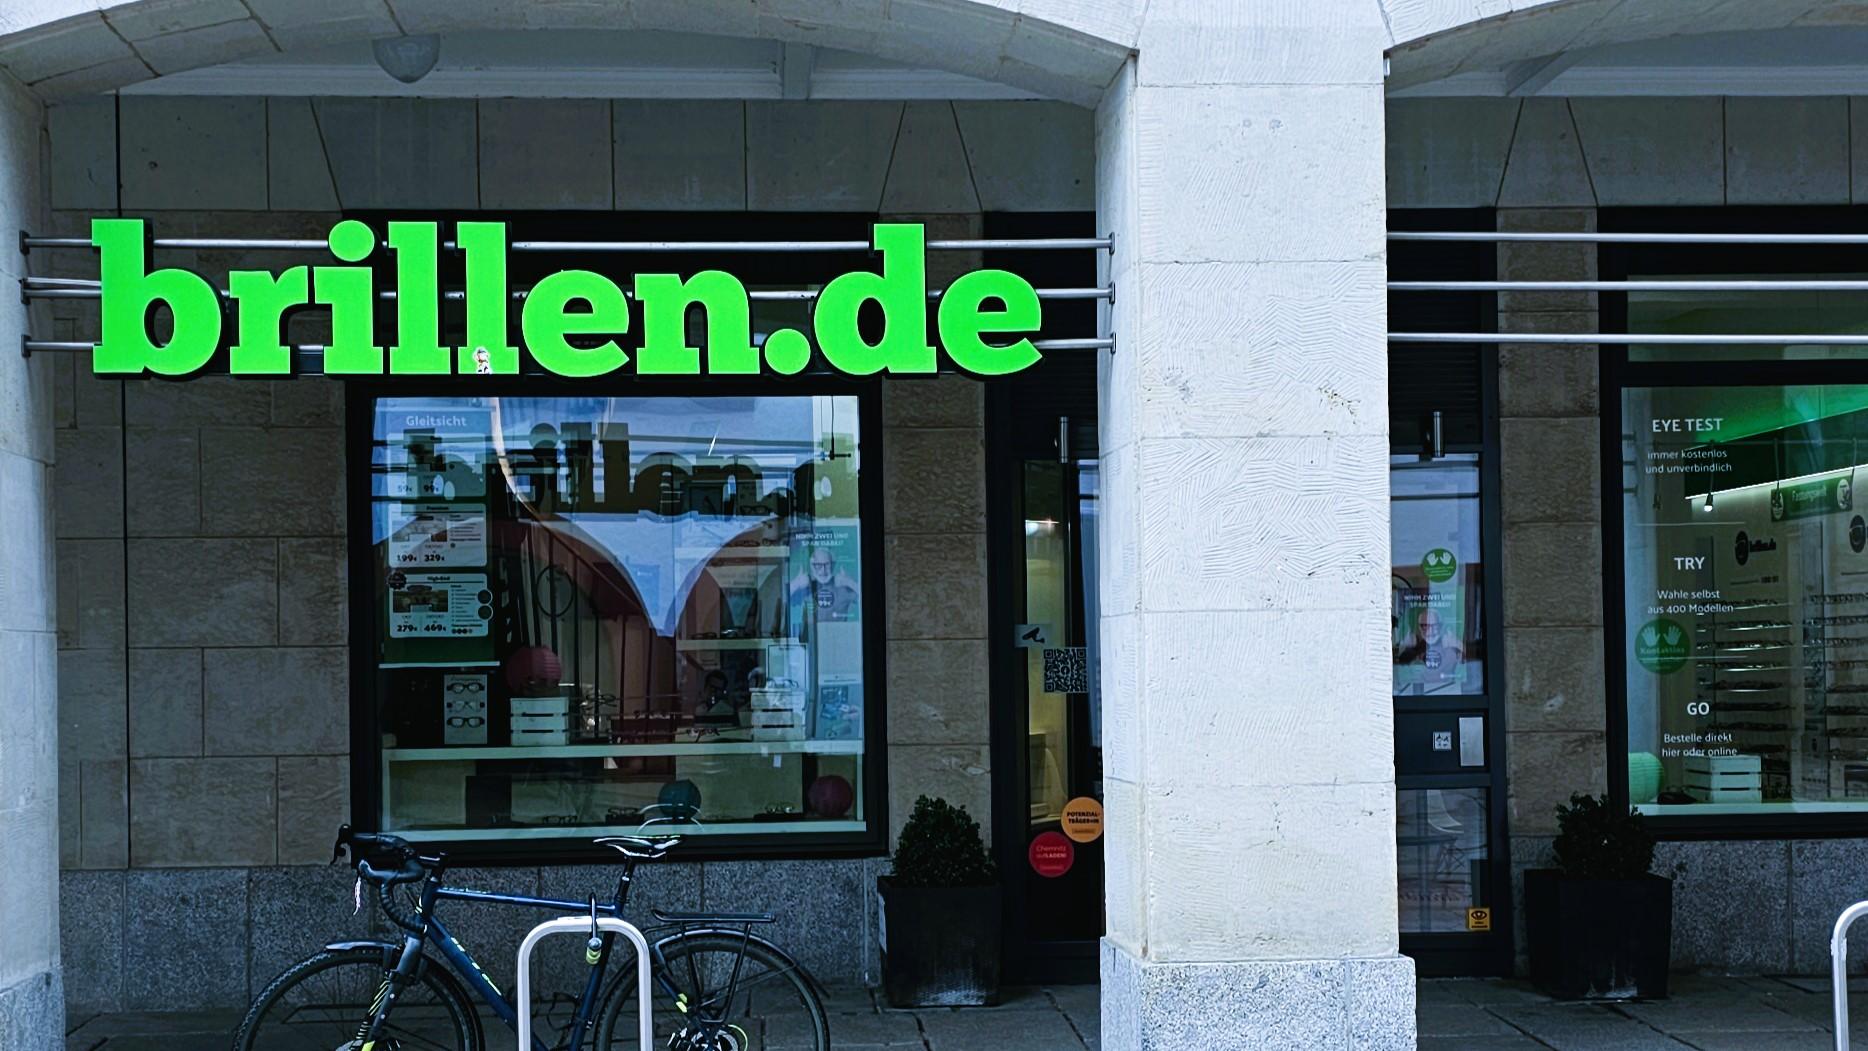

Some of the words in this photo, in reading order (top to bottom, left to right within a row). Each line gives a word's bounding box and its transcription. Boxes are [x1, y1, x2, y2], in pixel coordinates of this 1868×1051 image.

[91, 218, 1043, 376] brillen.de
[405, 415, 467, 427] Gleitsicht
[1652, 419, 1681, 432] EYE
[1684, 418, 1723, 431] TEST
[1647, 451, 1679, 460] immer
[1681, 449, 1727, 459] kostenlos
[1645, 464, 1664, 474] und
[1666, 463, 1732, 473] unverbindlich
[814, 532, 833, 540] ZWEI
[1674, 557, 1705, 570] TRY
[1690, 589, 1721, 599] selbst
[1647, 606, 1664, 614] aus
[1666, 605, 1686, 614] 400
[1688, 603, 1734, 613] Modellen
[1686, 702, 1710, 715] GO
[1664, 733, 1702, 743] Bestelle
[1705, 732, 1732, 743] direkt
[1662, 748, 1681, 757] hier
[1683, 747, 1705, 757] oder
[1708, 747, 1738, 757] online
